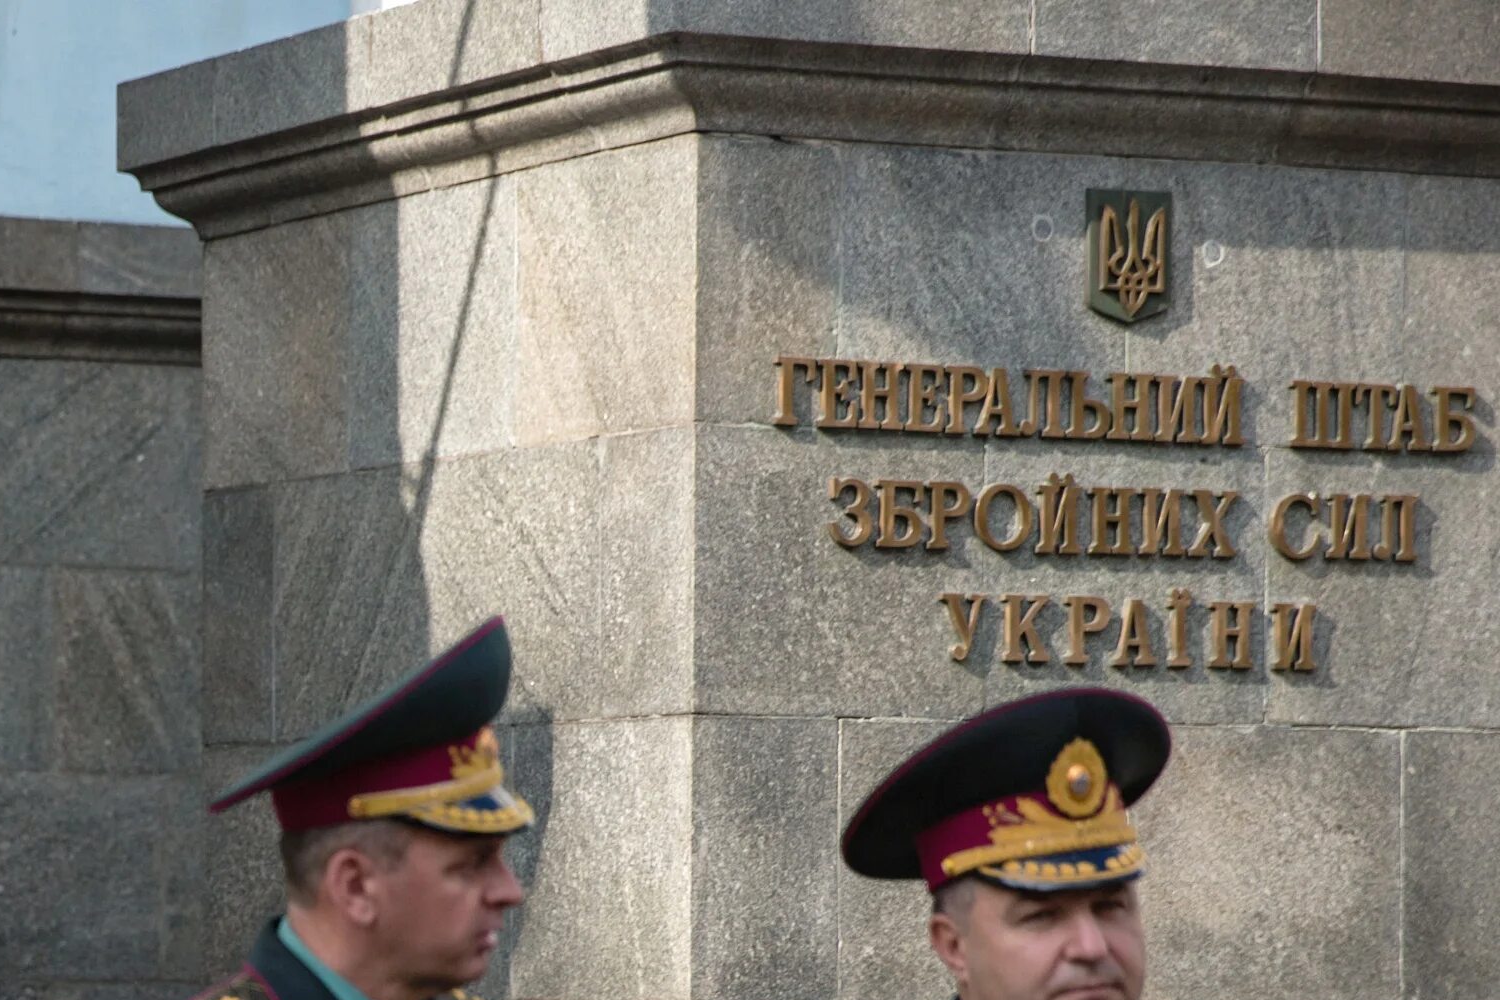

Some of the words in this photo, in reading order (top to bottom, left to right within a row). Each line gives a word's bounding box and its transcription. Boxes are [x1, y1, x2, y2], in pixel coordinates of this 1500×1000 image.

[773, 356, 1245, 446] ГЕНЕРАЛЬНИЙ
[1289, 380, 1477, 452] ШТАБ
[828, 472, 1239, 558] ЗБРОЙНИХ
[1268, 490, 1419, 562] СИЛ
[939, 588, 1317, 672] УКРАЇНИ
